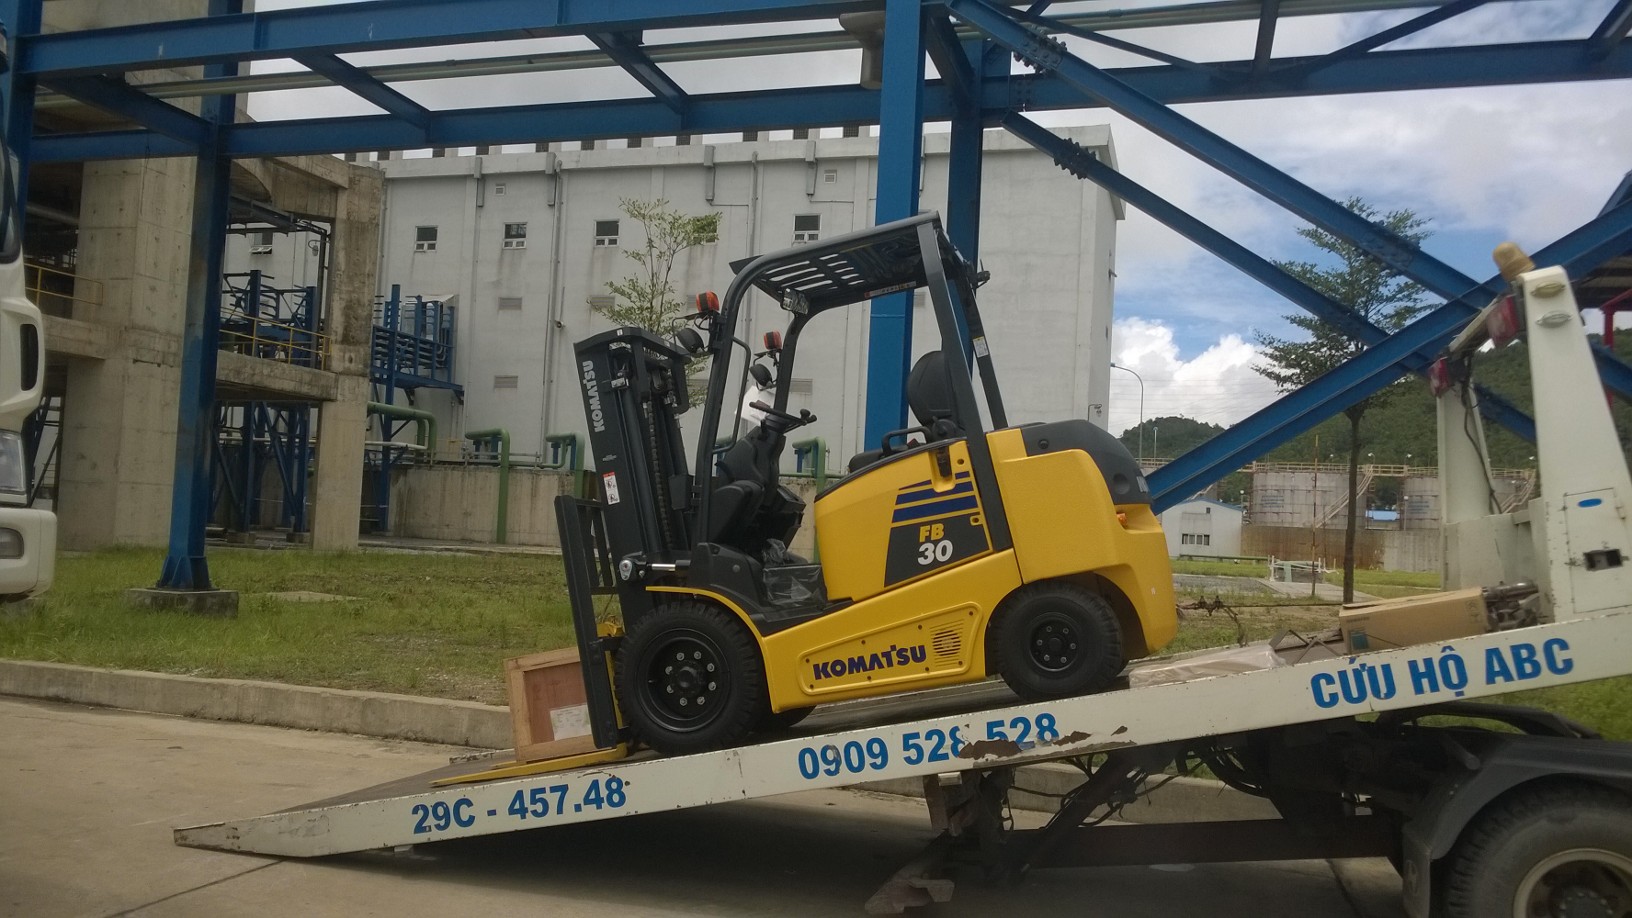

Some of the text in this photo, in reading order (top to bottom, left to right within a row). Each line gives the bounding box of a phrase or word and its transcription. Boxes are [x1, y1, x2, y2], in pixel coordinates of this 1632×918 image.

[582, 360, 606, 433] KOMATSU
[917, 539, 954, 566] 30
[919, 523, 945, 543] FB
[812, 644, 927, 681] KOMATSU
[1310, 637, 1575, 709] CỨU HỘ ABC
[797, 736, 890, 780] 0909
[411, 798, 476, 834] 29C
[507, 776, 628, 821] 457.48
